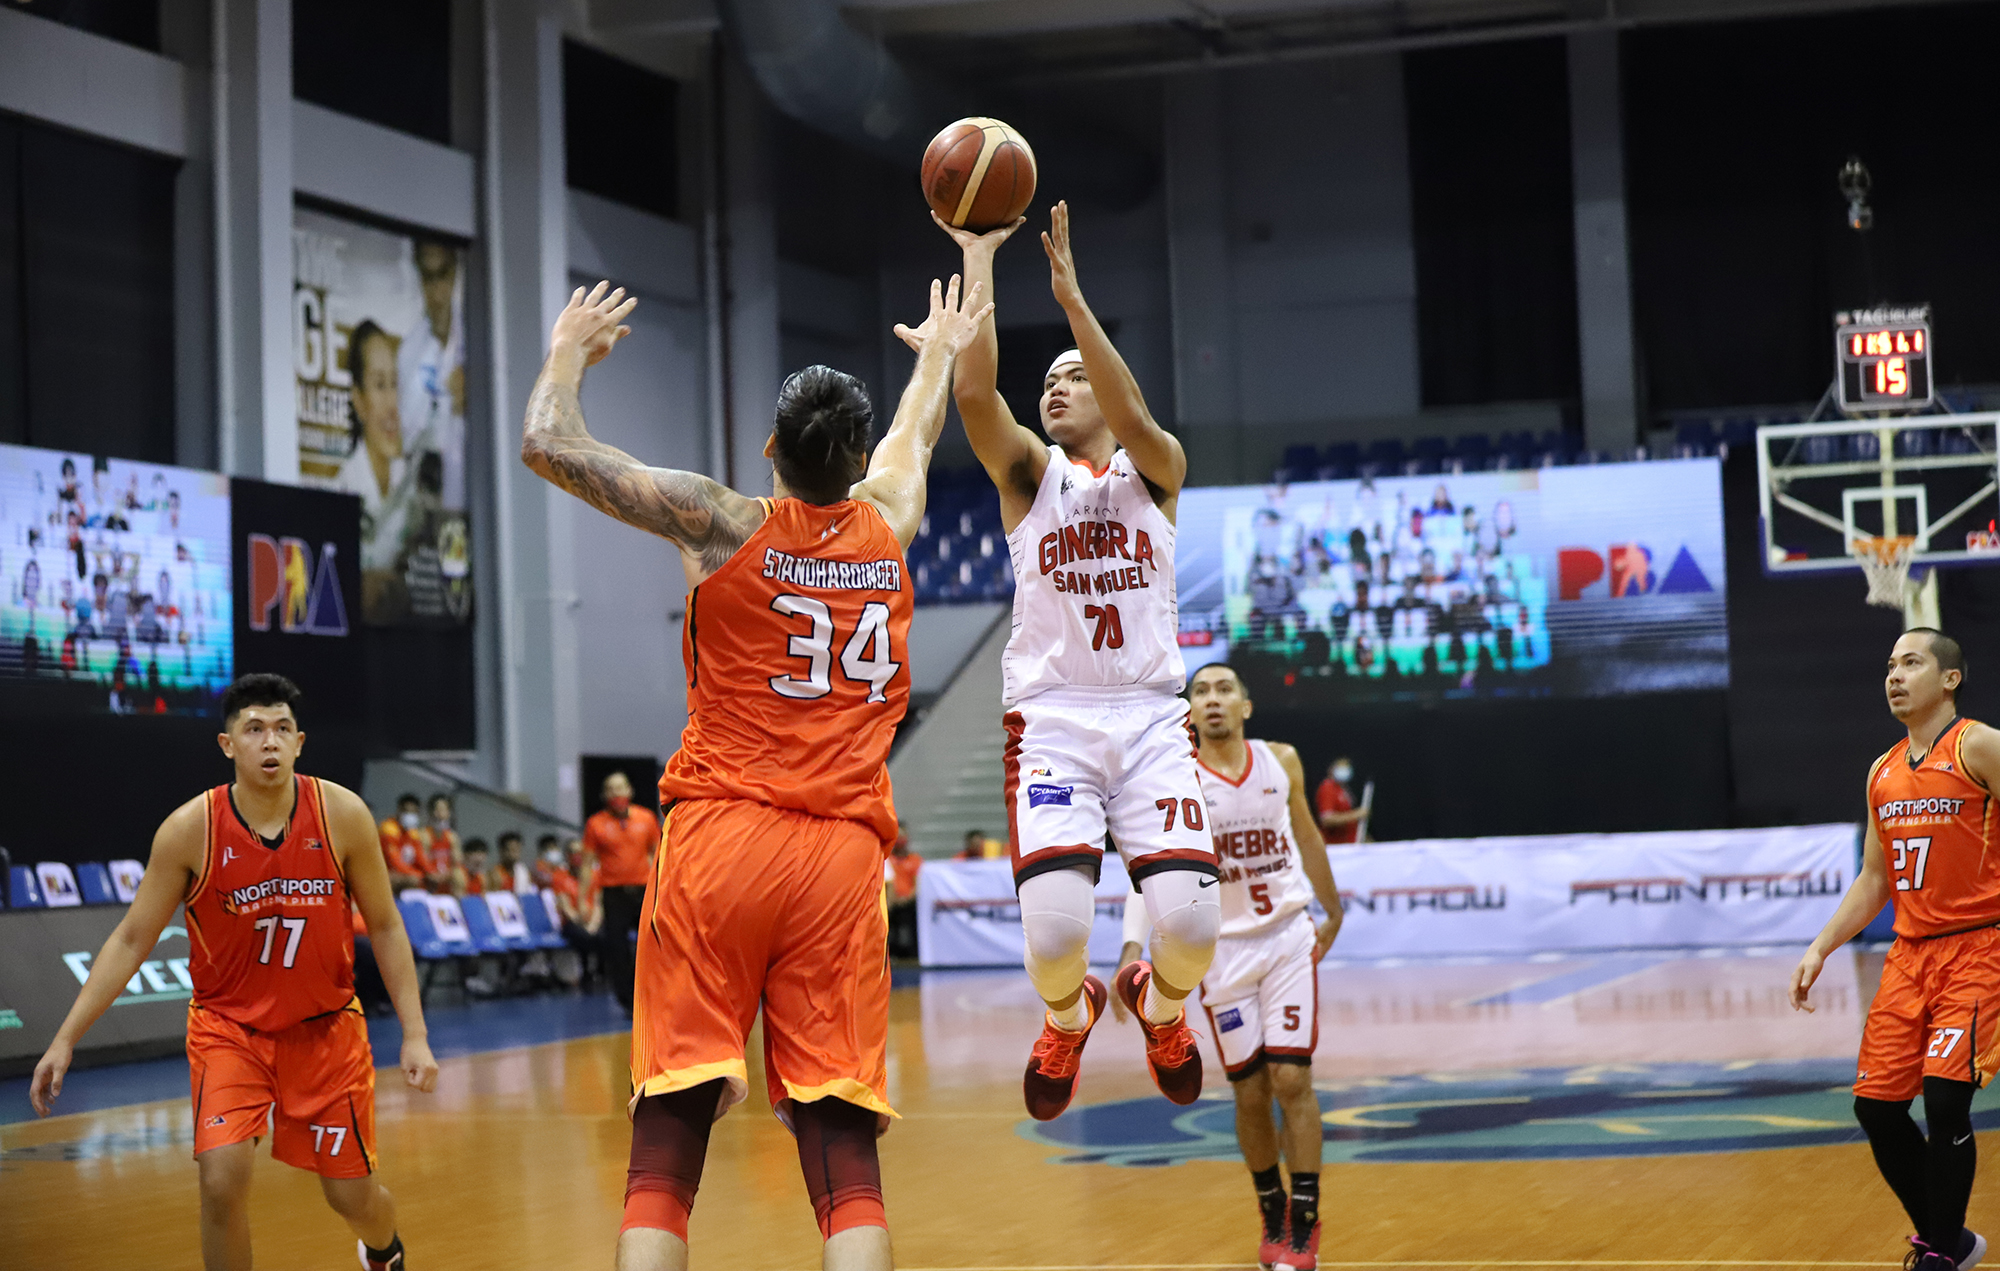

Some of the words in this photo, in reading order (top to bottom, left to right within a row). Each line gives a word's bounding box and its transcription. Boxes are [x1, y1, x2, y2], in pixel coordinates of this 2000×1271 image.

[1876, 357, 1908, 396] 15
[1039, 520, 1158, 576] GINEBRA
[763, 547, 901, 592] STANDHARDINGER
[1053, 570, 1091, 596] SAN
[1557, 541, 1714, 601] PBA
[1084, 604, 1124, 651] 70
[768, 593, 902, 703] 34
[1155, 797, 1204, 832] 70
[1878, 798, 1964, 821] NORTHPORT
[1890, 836, 1933, 891] 27
[233, 877, 336, 905] NORTHPORT
[291, 897, 324, 905] PIER
[1248, 883, 1274, 916] 5
[1568, 869, 1842, 907] FRONTROW
[253, 915, 307, 970] 77
[1283, 1005, 1301, 1031] 5
[1926, 1027, 1966, 1058] 27
[309, 1123, 347, 1157] 77
